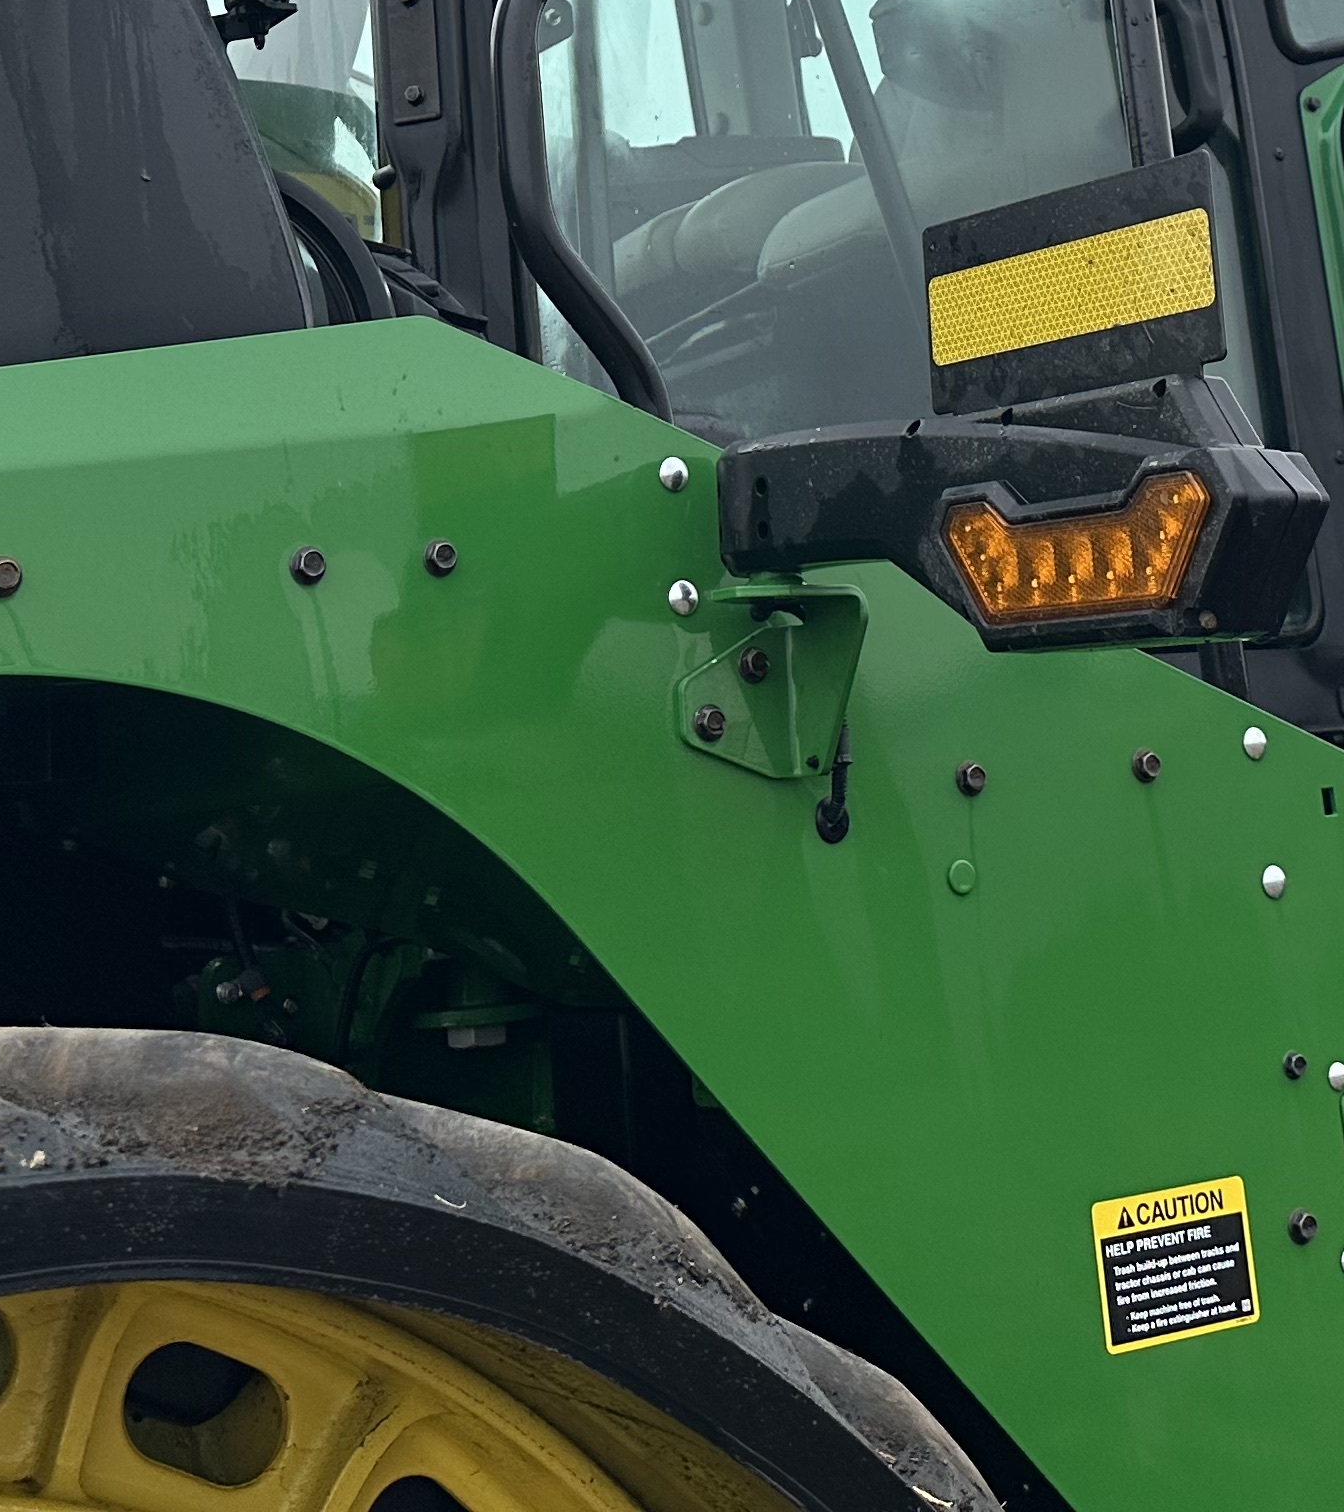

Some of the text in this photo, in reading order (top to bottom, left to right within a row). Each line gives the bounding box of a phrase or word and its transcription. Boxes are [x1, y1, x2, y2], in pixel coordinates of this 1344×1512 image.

[1136, 1188, 1224, 1225] CAUTION
[1106, 1225, 1212, 1258] HELP PREVENT FIRE
[1113, 1242, 1240, 1276] Trash build-up between tracks and
[1115, 1259, 1235, 1291] tractor chassis or cab can cause
[1116, 1277, 1218, 1306] fire from increased friction.
[1130, 1309, 1148, 1321] Keep
[1149, 1303, 1178, 1317] machine
[1178, 1300, 1192, 1310] free
[1192, 1298, 1201, 1307] of
[1131, 1321, 1150, 1334] Keep
[1156, 1317, 1168, 1328] fire
